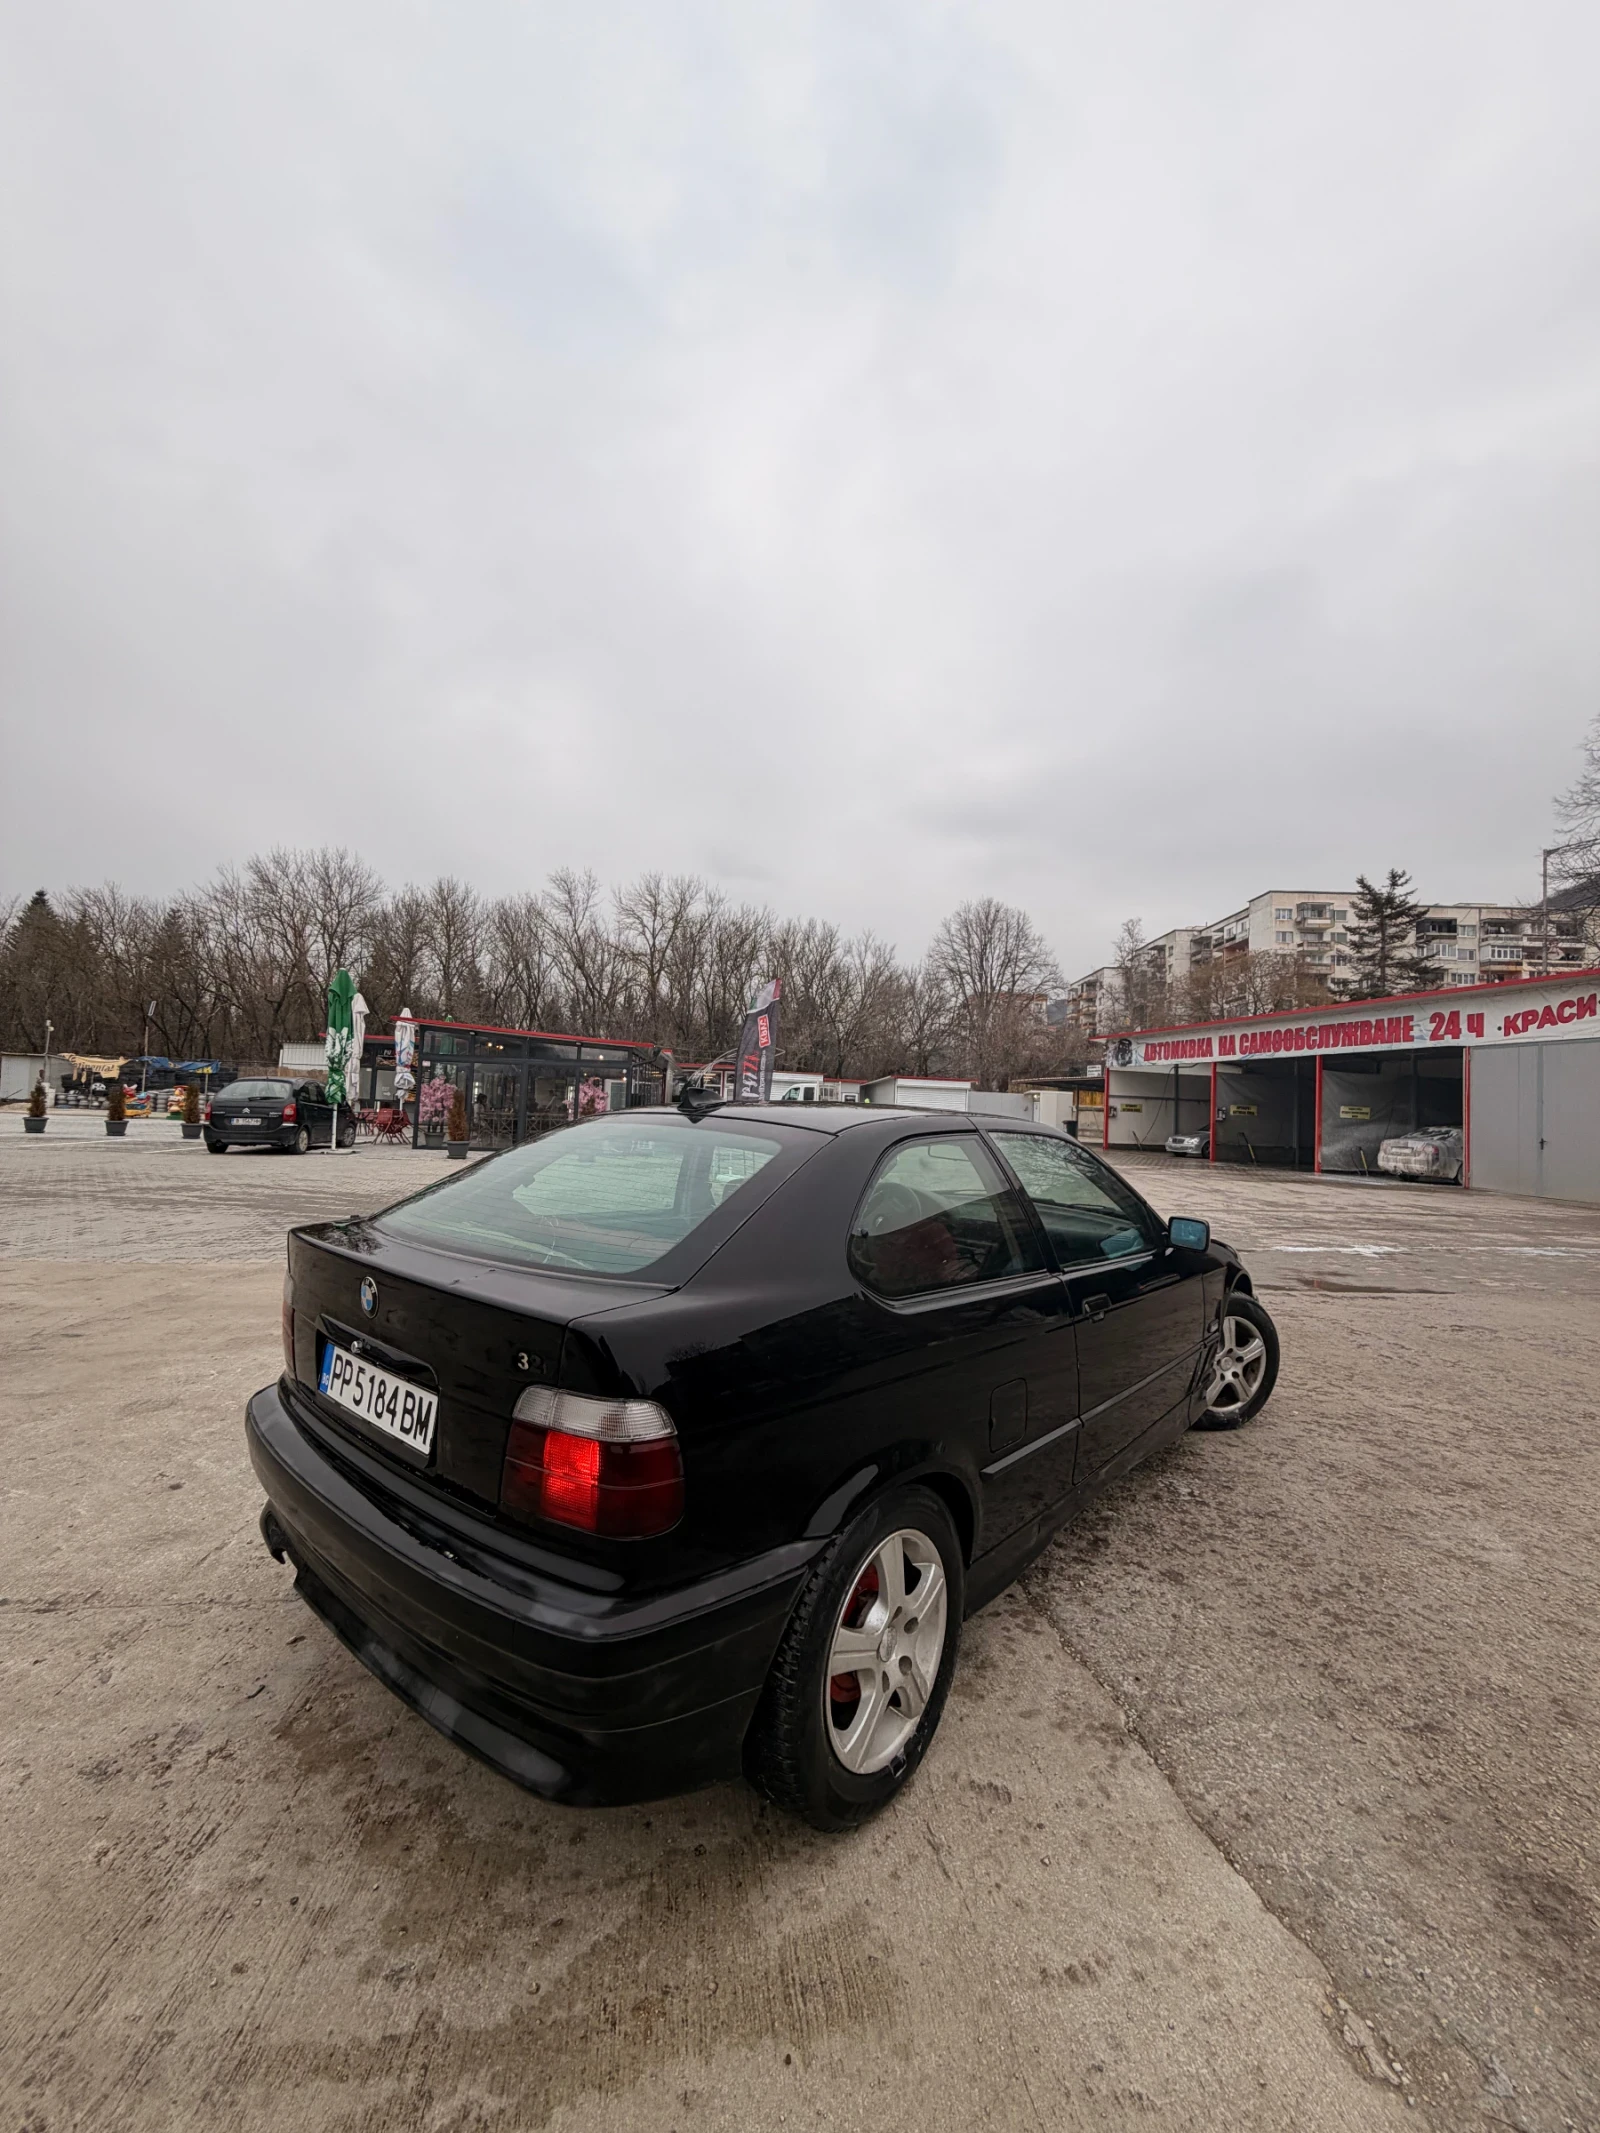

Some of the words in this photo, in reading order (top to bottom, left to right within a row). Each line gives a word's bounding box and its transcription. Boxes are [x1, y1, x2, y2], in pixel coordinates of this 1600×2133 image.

[1144, 1037, 1213, 1061] АВТОМИВКА
[1218, 1034, 1236, 1056] НА
[1239, 1015, 1415, 1055] САМООБСЛУЖВАНЕ
[1429, 1010, 1461, 1041] 24
[1503, 993, 1597, 1037] КРАСИ
